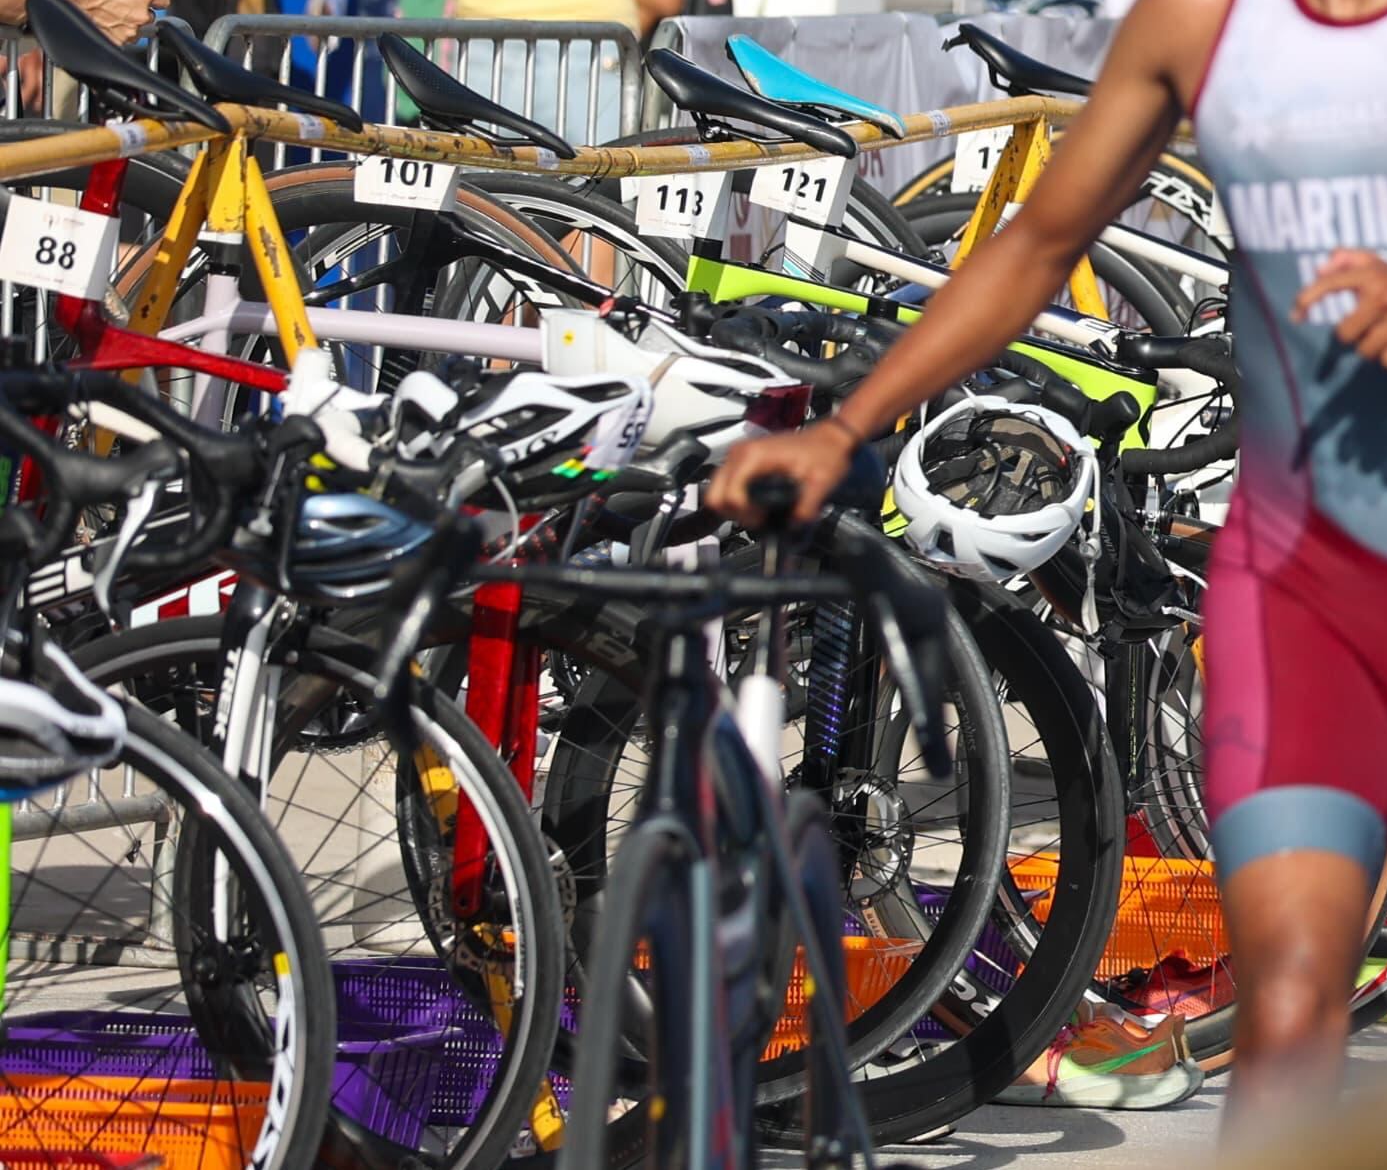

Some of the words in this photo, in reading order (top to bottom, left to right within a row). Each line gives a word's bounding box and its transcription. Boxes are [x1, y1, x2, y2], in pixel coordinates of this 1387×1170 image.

[380, 158, 434, 188] 101
[782, 167, 827, 203] 121
[656, 185, 704, 216] 113
[35, 236, 77, 270] 88
[213, 646, 242, 741] TREK
